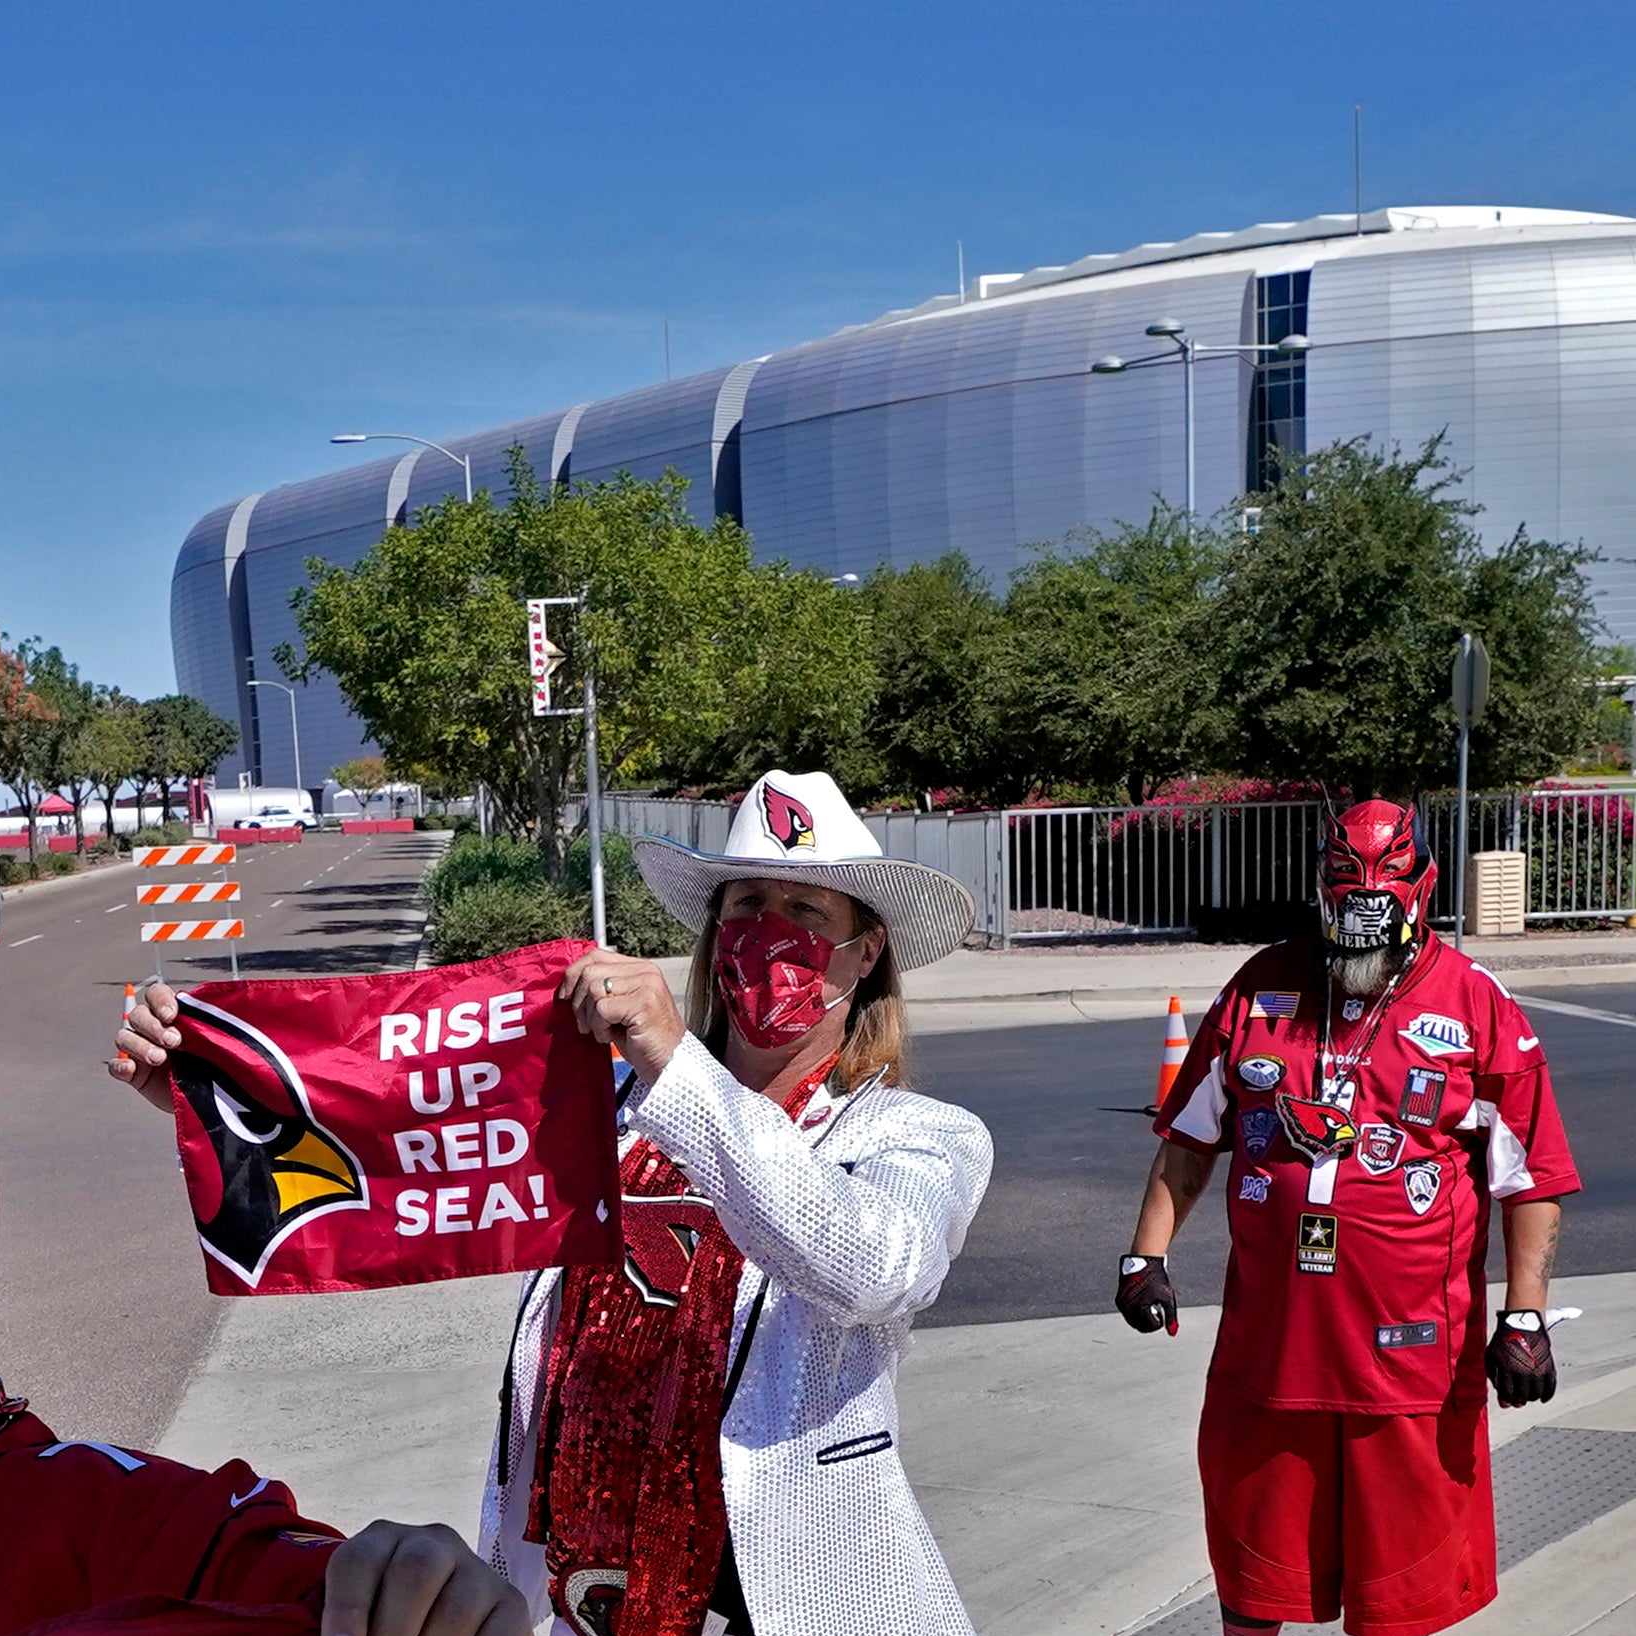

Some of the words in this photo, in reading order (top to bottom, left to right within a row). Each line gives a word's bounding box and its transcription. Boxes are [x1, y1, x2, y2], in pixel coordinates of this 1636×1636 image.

[379, 991, 527, 1061] RISE
[1412, 1020, 1466, 1049] XLIII
[409, 1062, 501, 1114] UP
[393, 1119, 529, 1174] RED
[394, 1174, 550, 1237] SEA!
